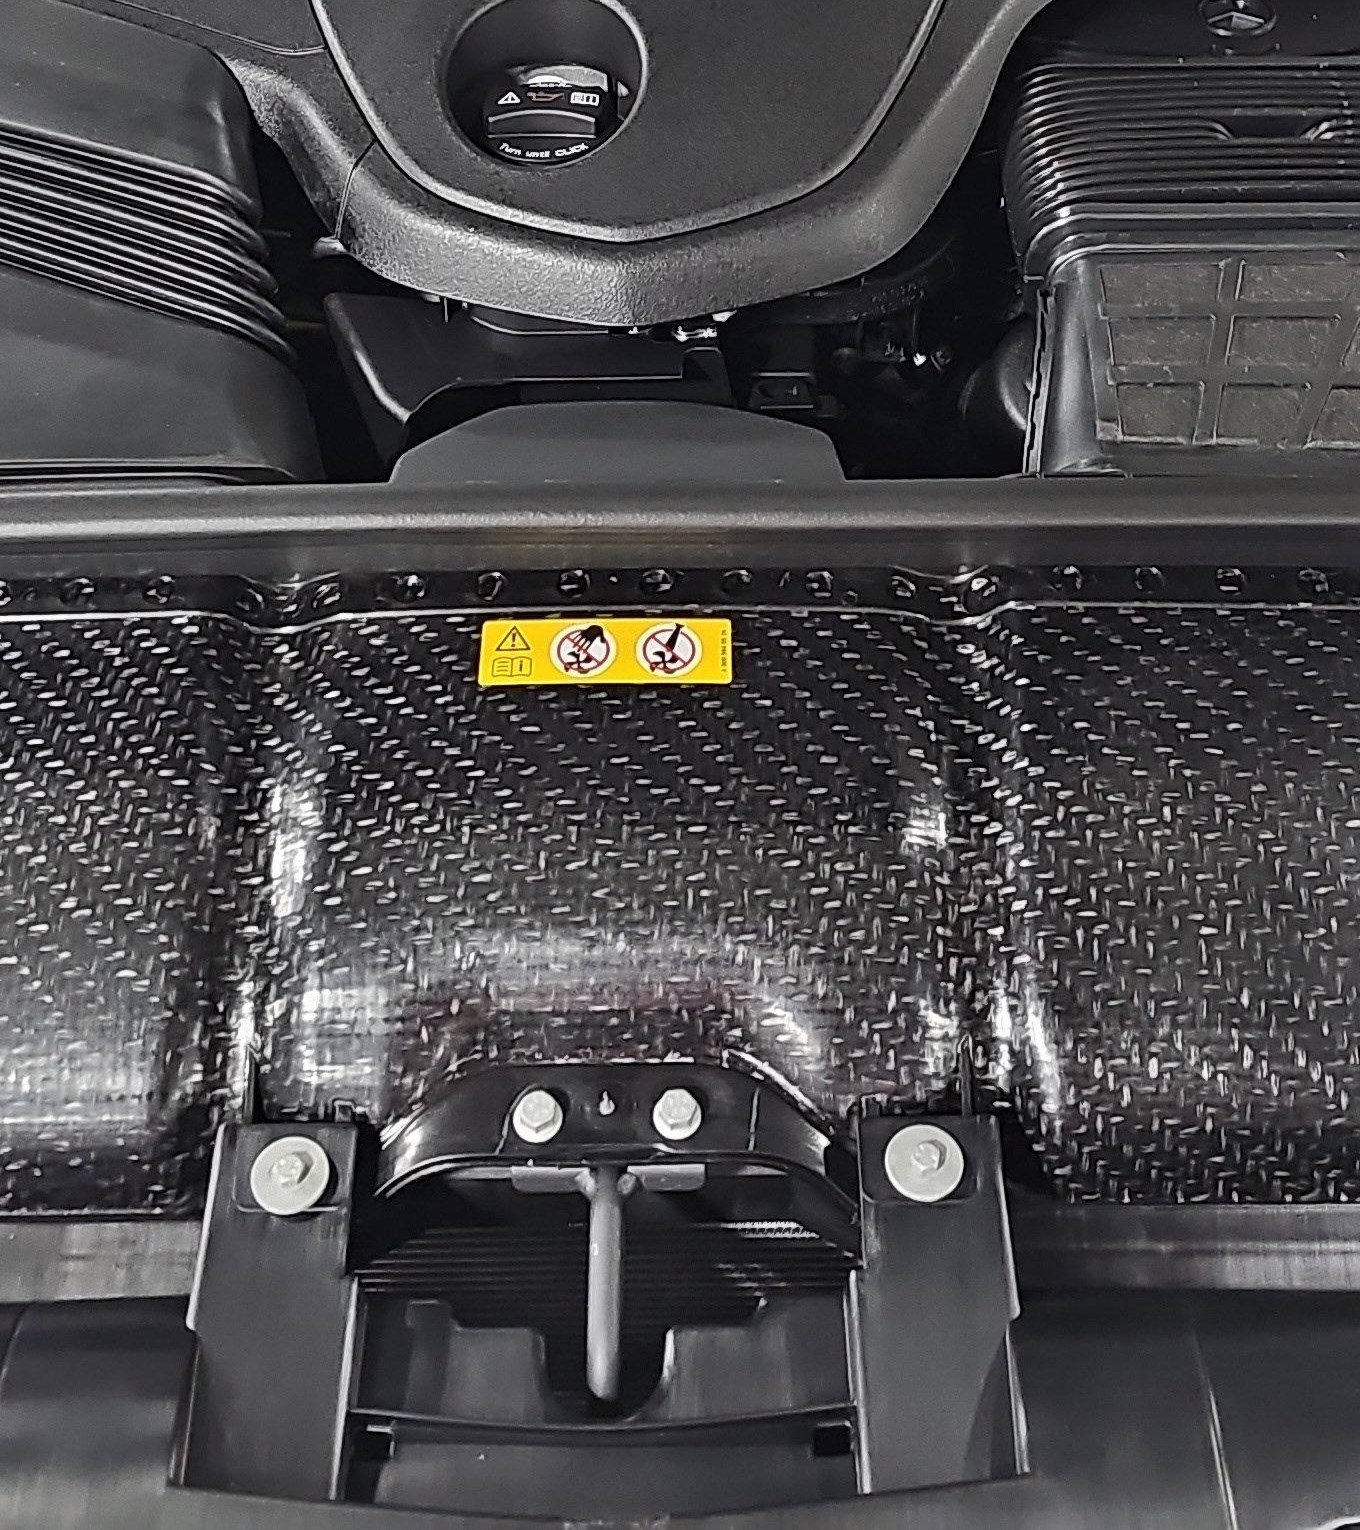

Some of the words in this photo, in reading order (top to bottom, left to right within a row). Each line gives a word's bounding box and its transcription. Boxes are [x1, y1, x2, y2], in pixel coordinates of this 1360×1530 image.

[499, 142, 522, 156] Turn
[525, 150, 550, 158] until
[555, 142, 589, 157] CLICK
